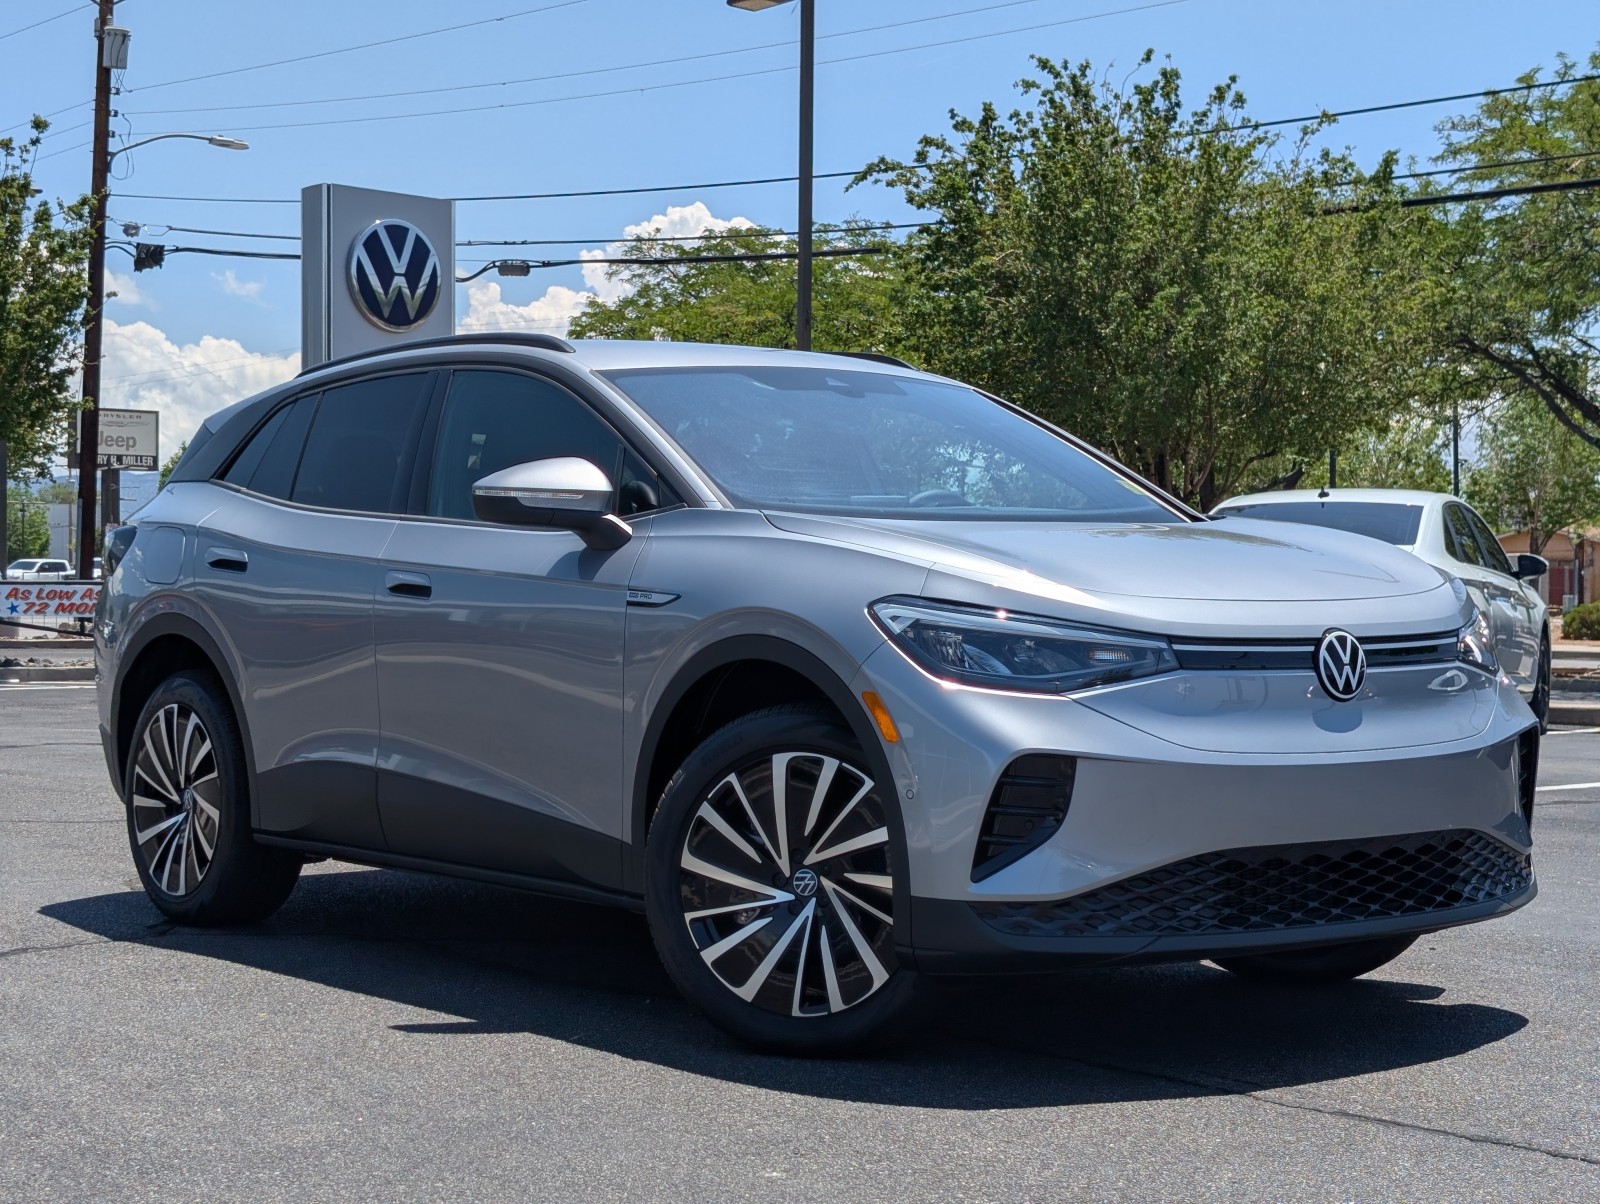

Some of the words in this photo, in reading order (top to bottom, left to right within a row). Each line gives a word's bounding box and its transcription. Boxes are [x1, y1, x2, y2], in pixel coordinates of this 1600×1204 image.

[98, 430, 138, 451] Jeep
[122, 455, 154, 467] MILLER
[22, 601, 51, 615] 72
